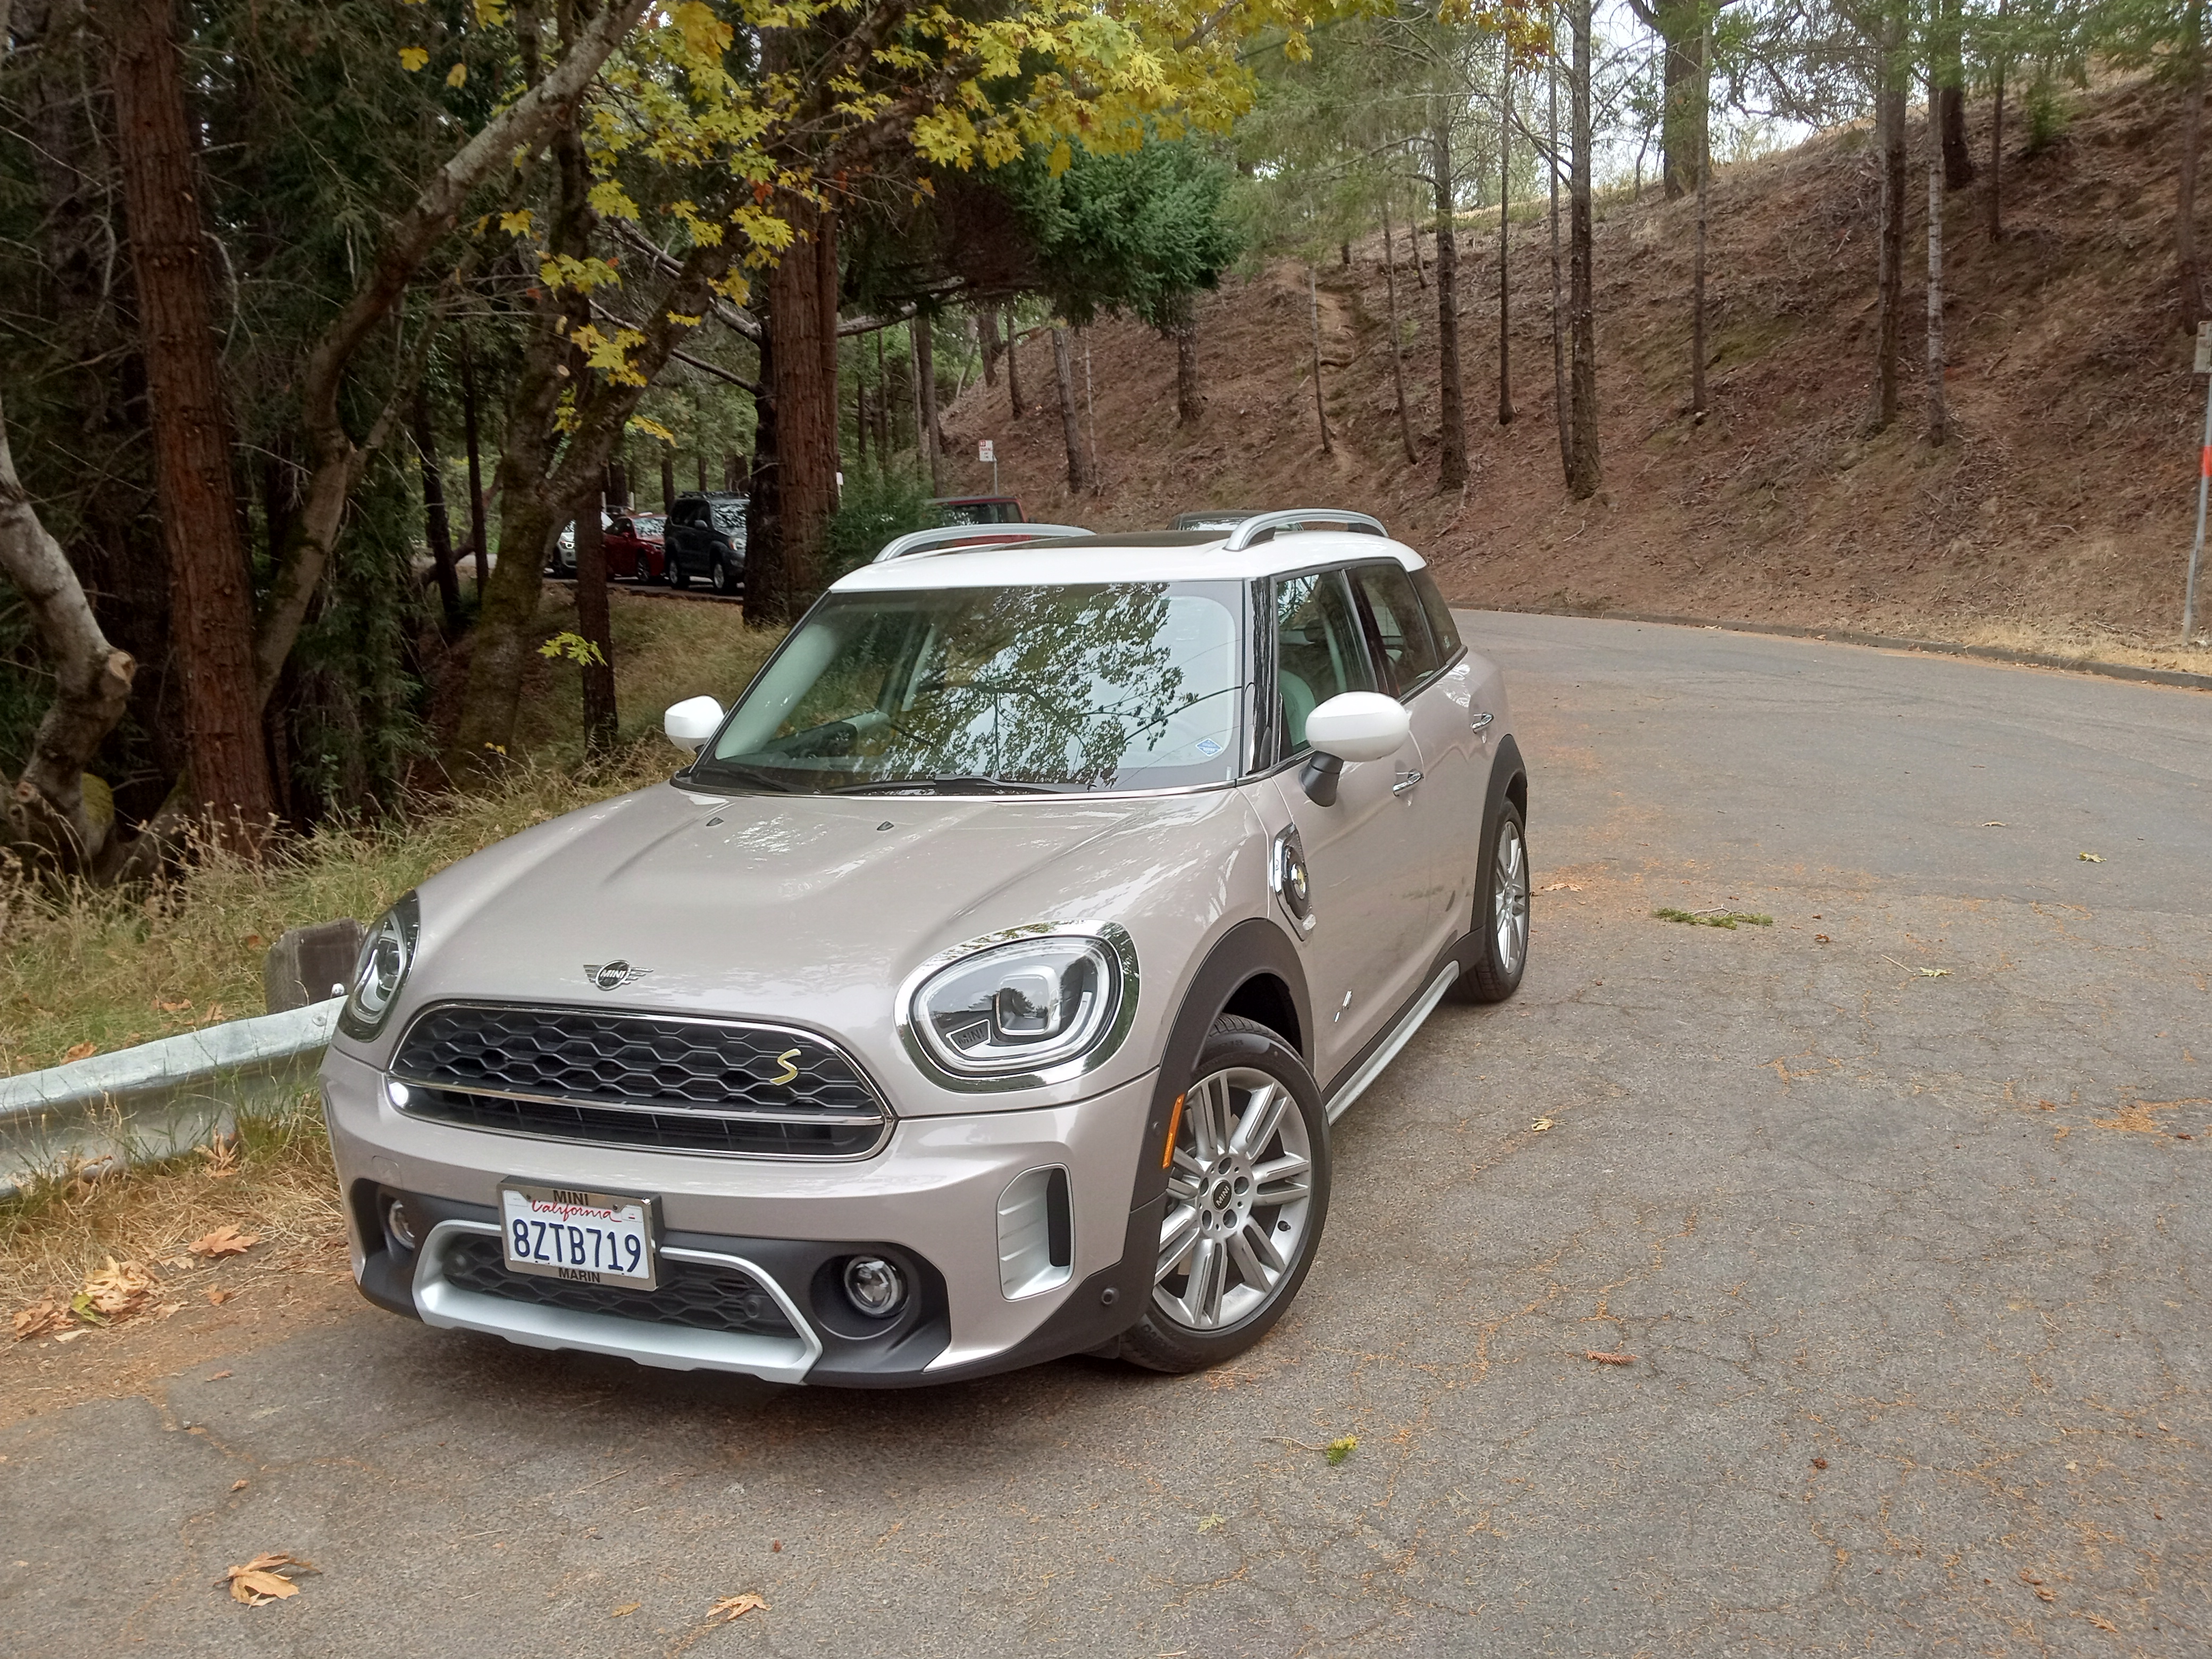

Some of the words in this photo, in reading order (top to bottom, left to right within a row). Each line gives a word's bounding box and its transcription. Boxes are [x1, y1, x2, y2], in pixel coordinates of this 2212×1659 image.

[600, 969, 626, 978] MINI
[769, 1048, 801, 1086] S
[553, 1190, 589, 1205] MINI
[1216, 1185, 1230, 1206] MINI
[532, 1200, 622, 1222] California
[513, 1219, 641, 1272] 8ZTB719
[559, 1268, 600, 1283] MARIN
